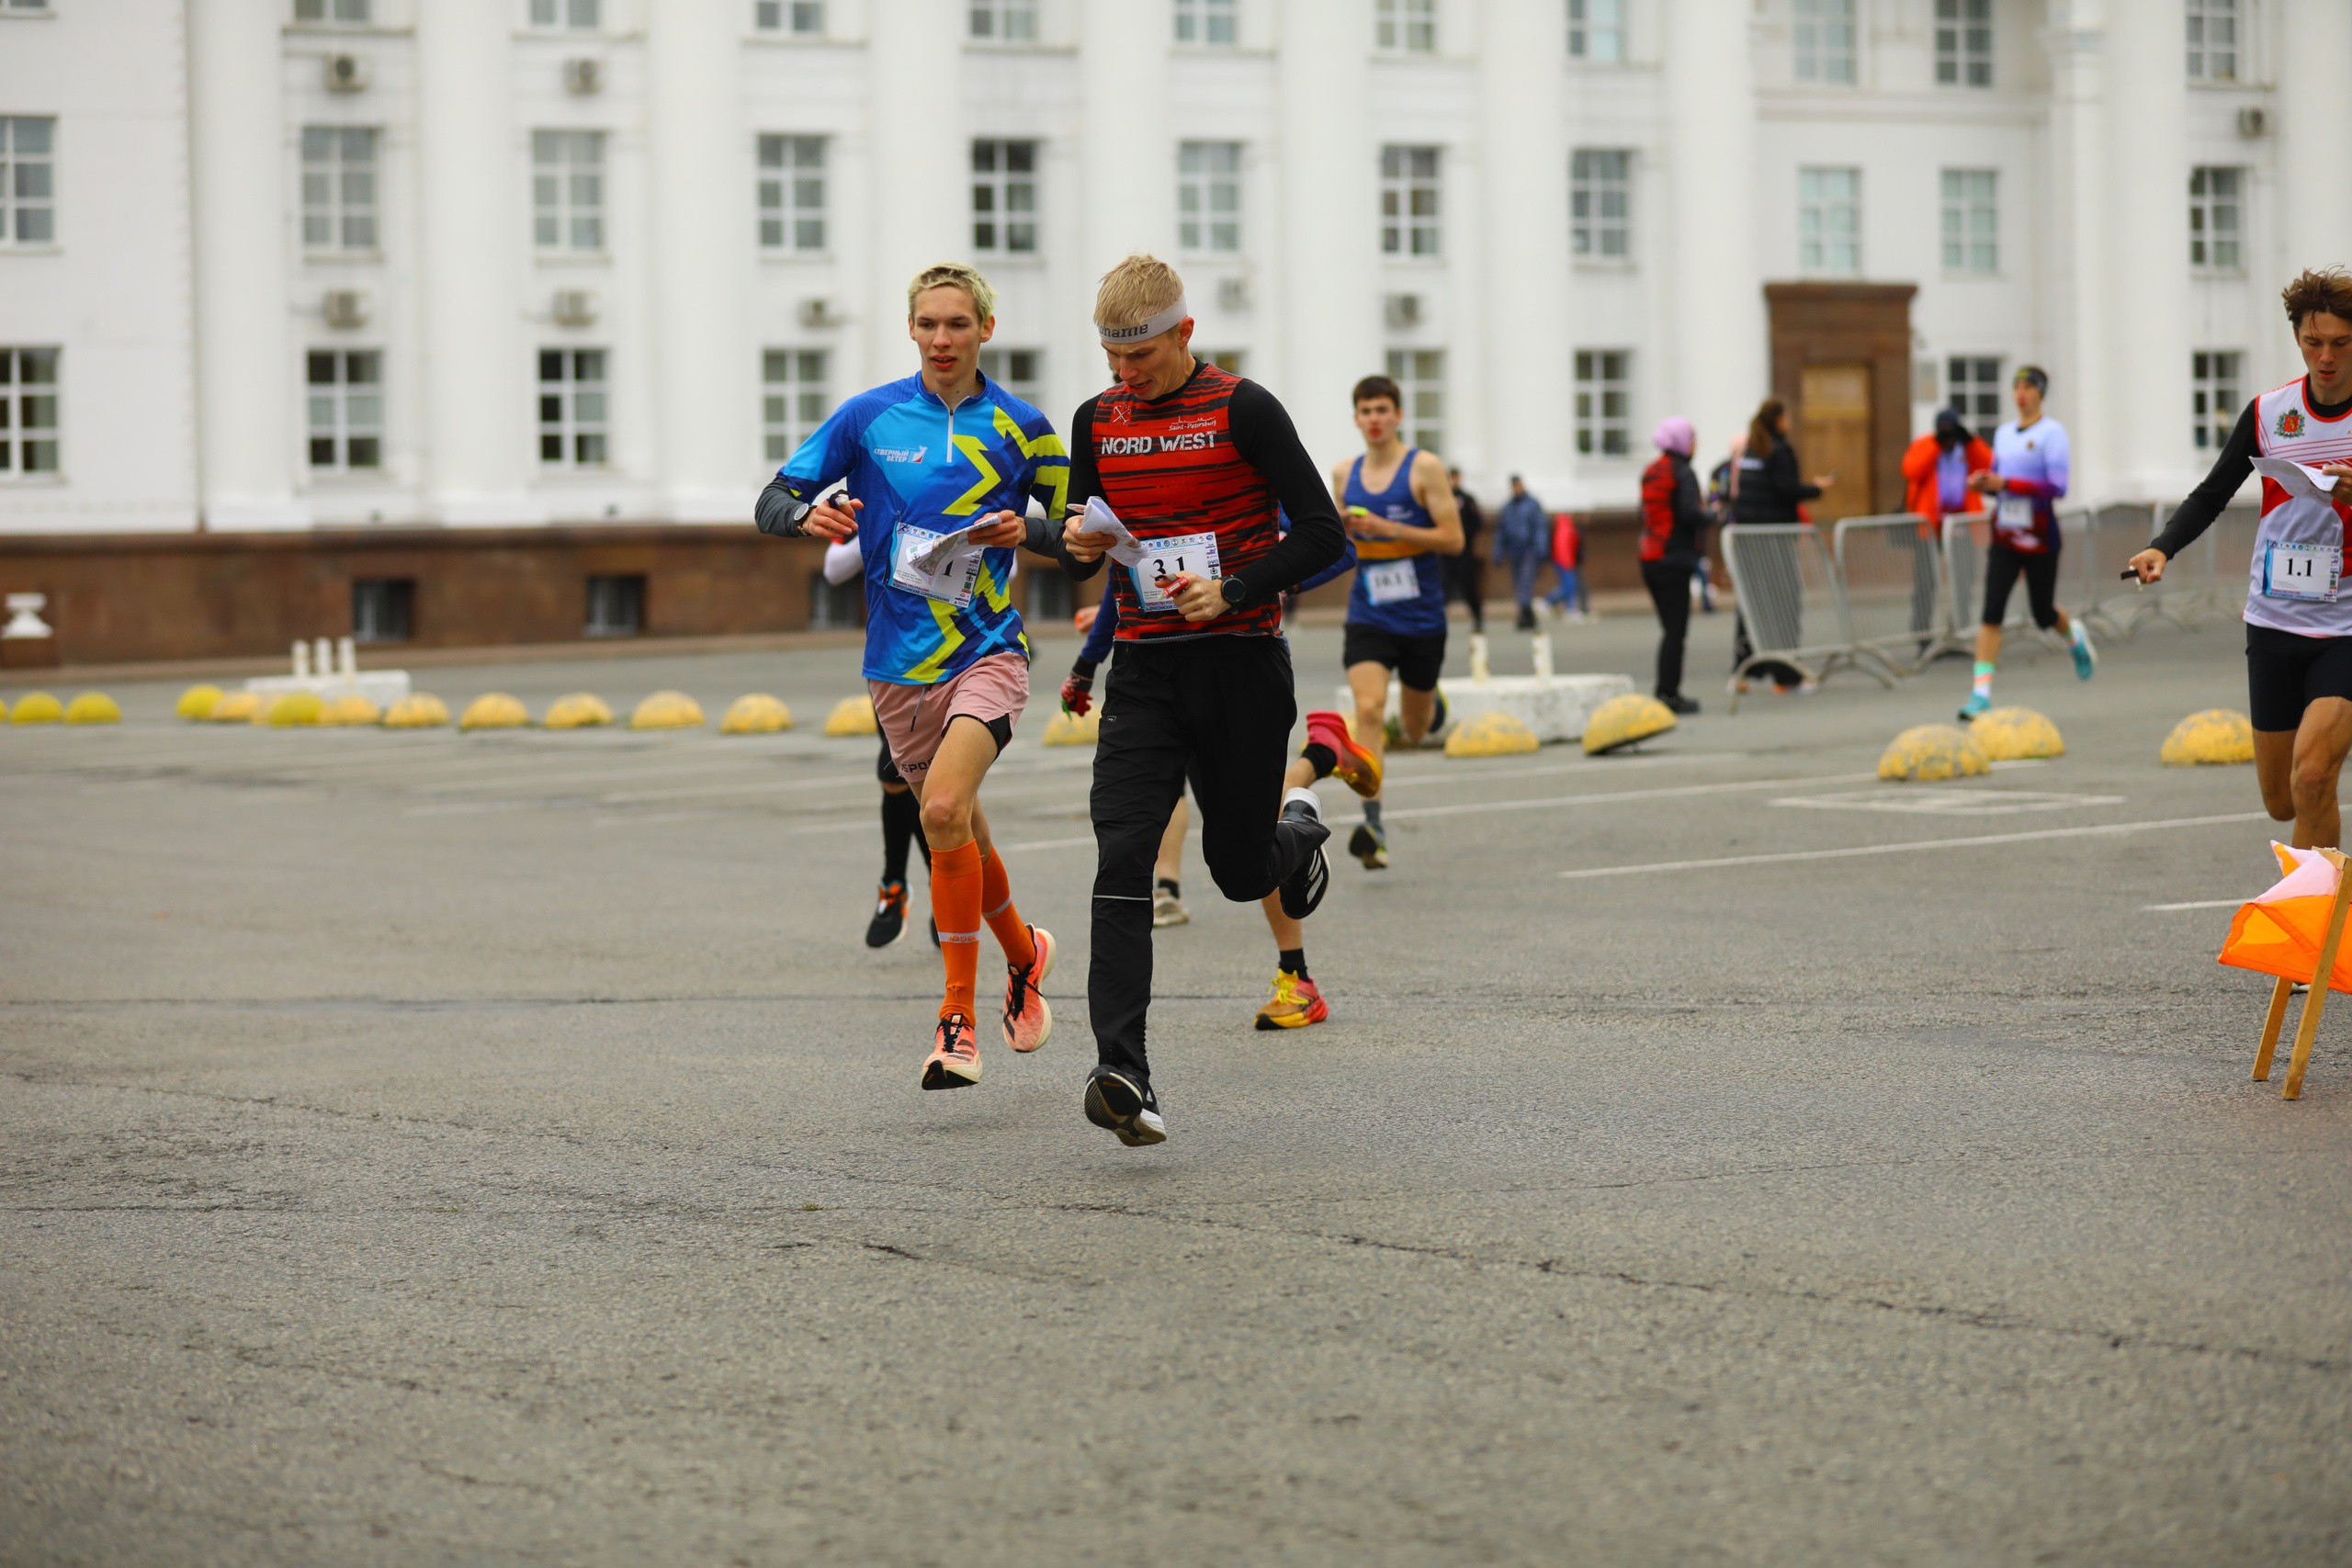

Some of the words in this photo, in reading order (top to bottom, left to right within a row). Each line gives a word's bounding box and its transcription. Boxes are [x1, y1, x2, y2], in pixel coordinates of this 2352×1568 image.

[1169, 420, 1216, 431] Saint-Petersburg
[1102, 436, 1152, 454] NORD
[1159, 430, 1217, 452] WEST
[874, 448, 909, 457] СЕВЕРНЫЙ
[2287, 558, 2312, 577] 1.1
